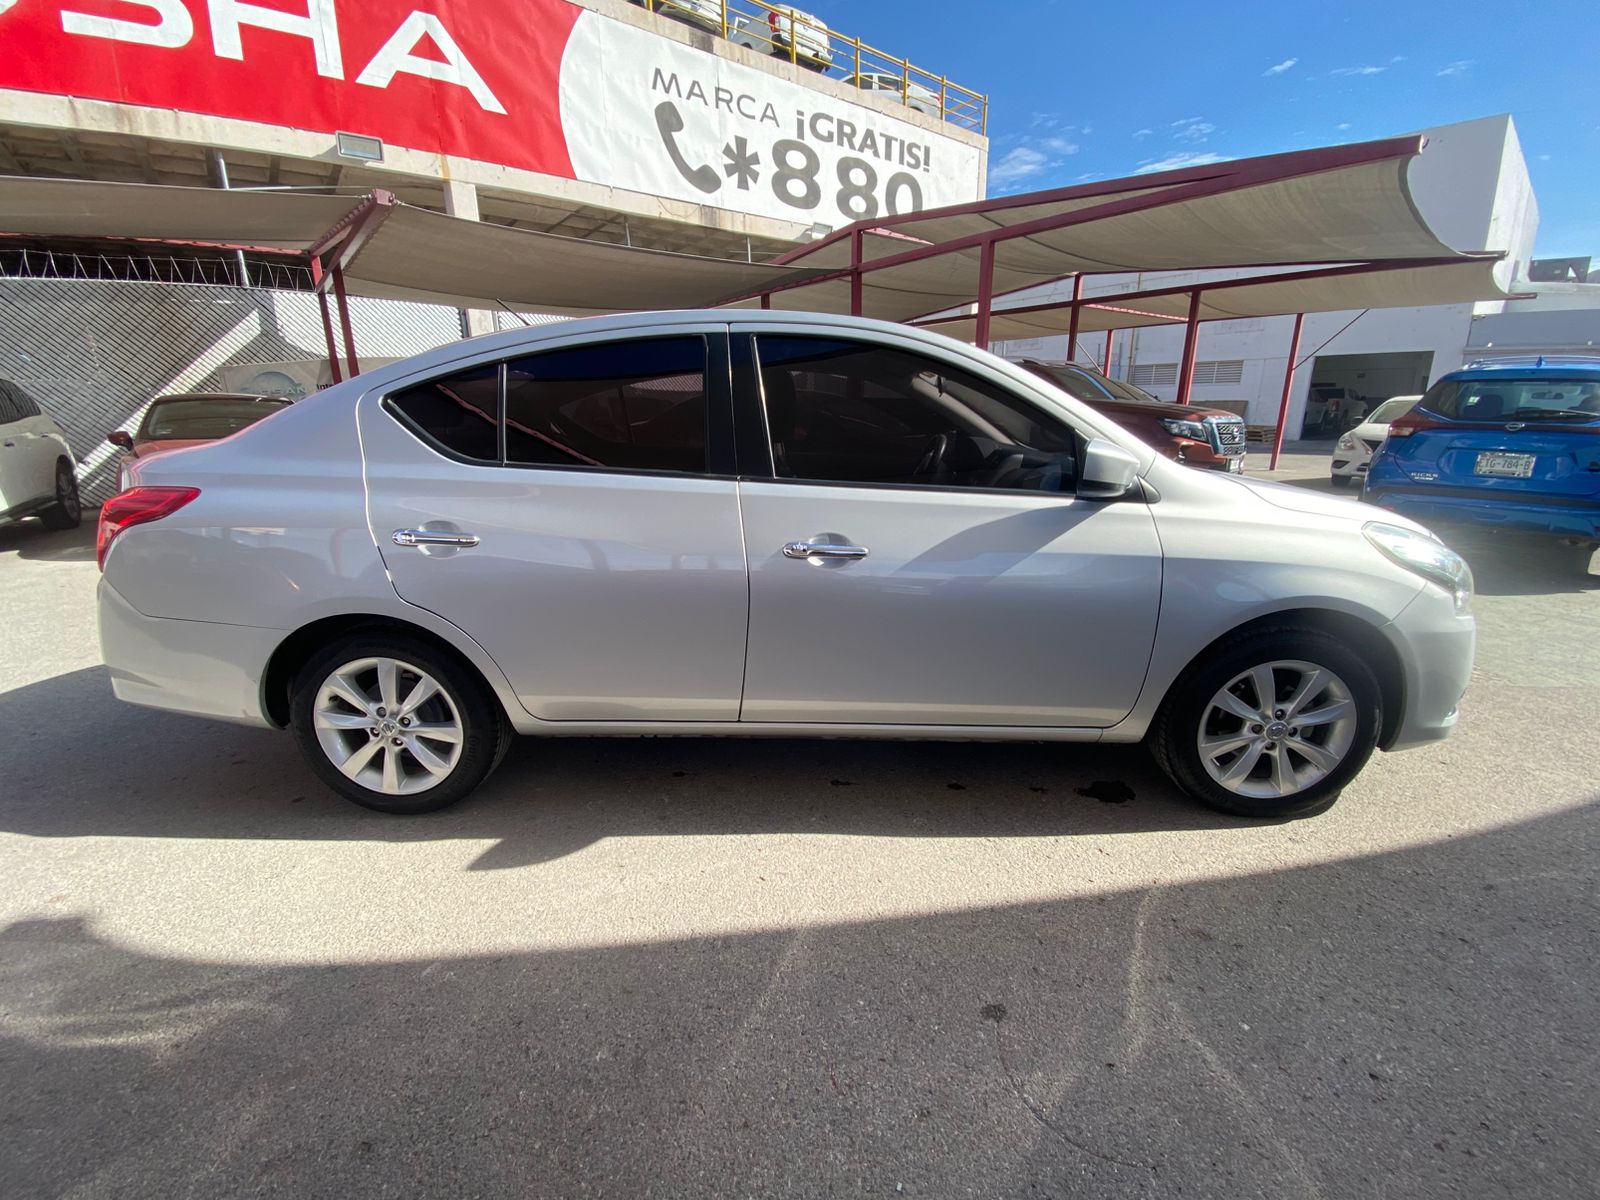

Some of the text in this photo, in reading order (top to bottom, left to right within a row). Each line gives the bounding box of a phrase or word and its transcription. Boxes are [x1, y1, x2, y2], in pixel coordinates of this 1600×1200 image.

[0, 0, 507, 114] SHA
[652, 68, 930, 172] MARCA ¡GRATIS!
